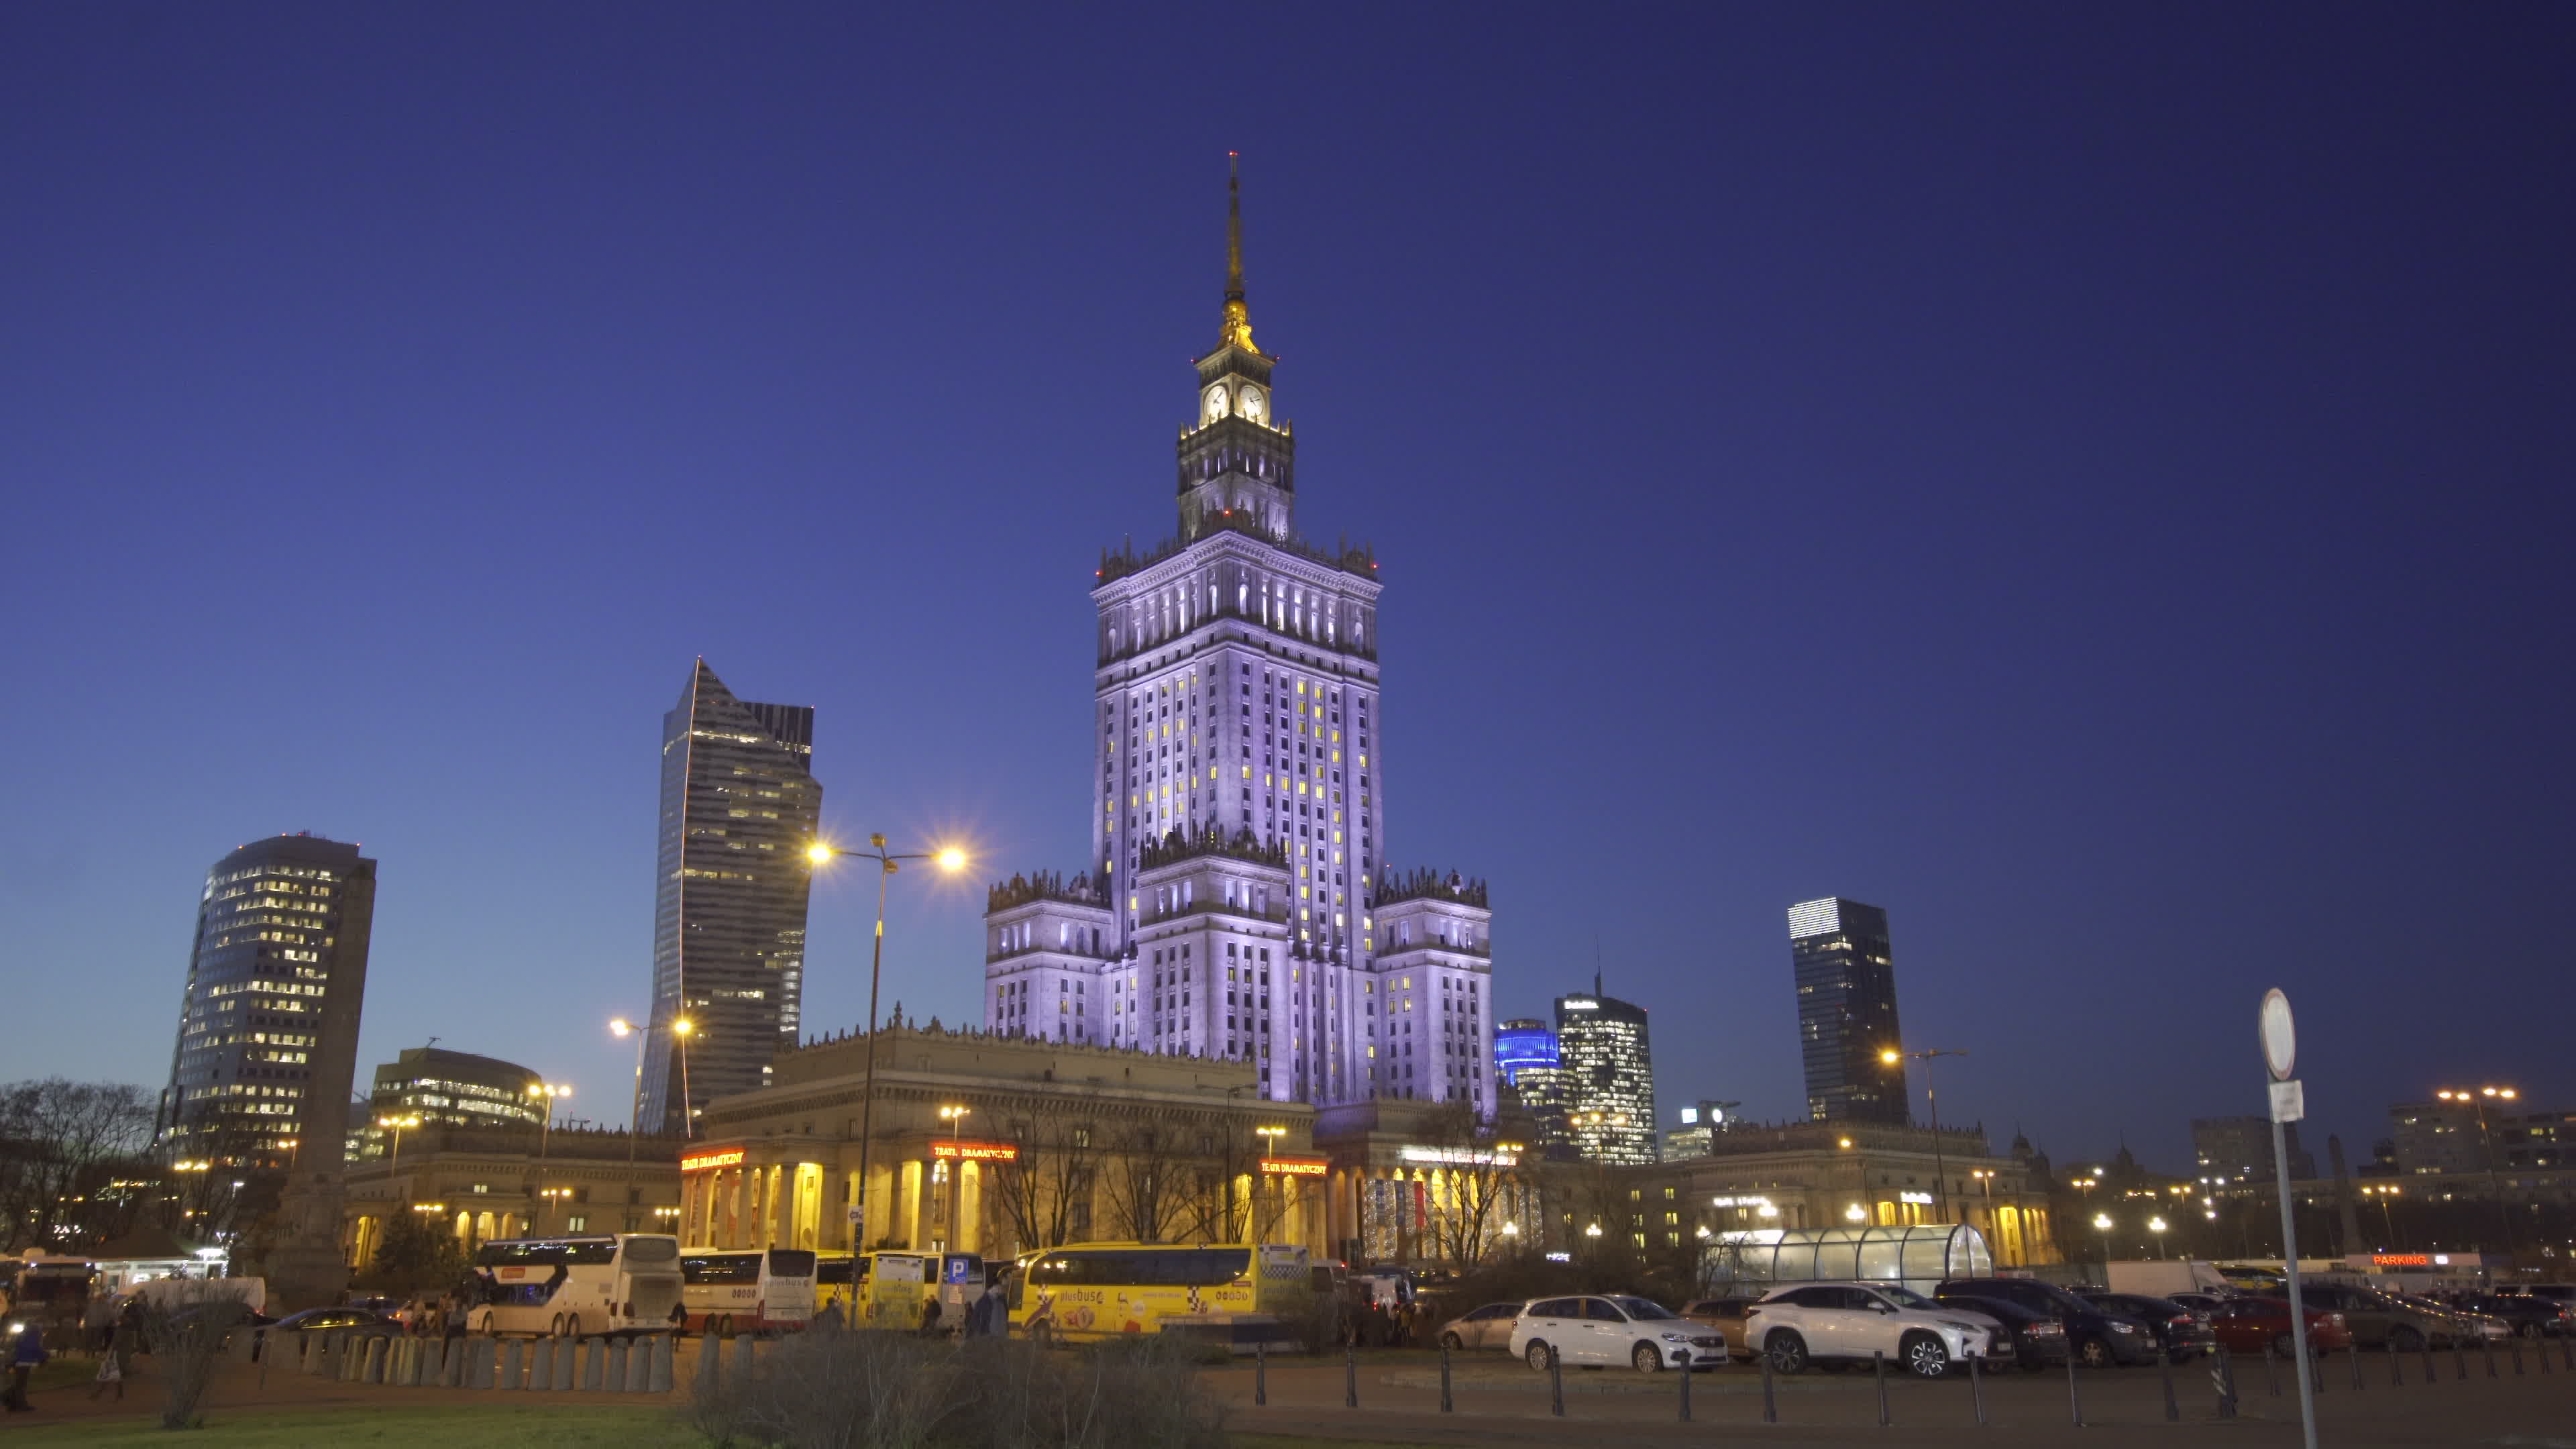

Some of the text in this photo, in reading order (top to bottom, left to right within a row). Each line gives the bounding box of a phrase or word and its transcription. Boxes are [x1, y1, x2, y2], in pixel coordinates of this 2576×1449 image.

[682, 1152, 744, 1170] TEATR DRAMATYCZNY
[1262, 1163, 1326, 1174] TEATR DRAMATYCZNY
[2373, 1255, 2426, 1265] PARKING
[953, 1262, 964, 1277] P
